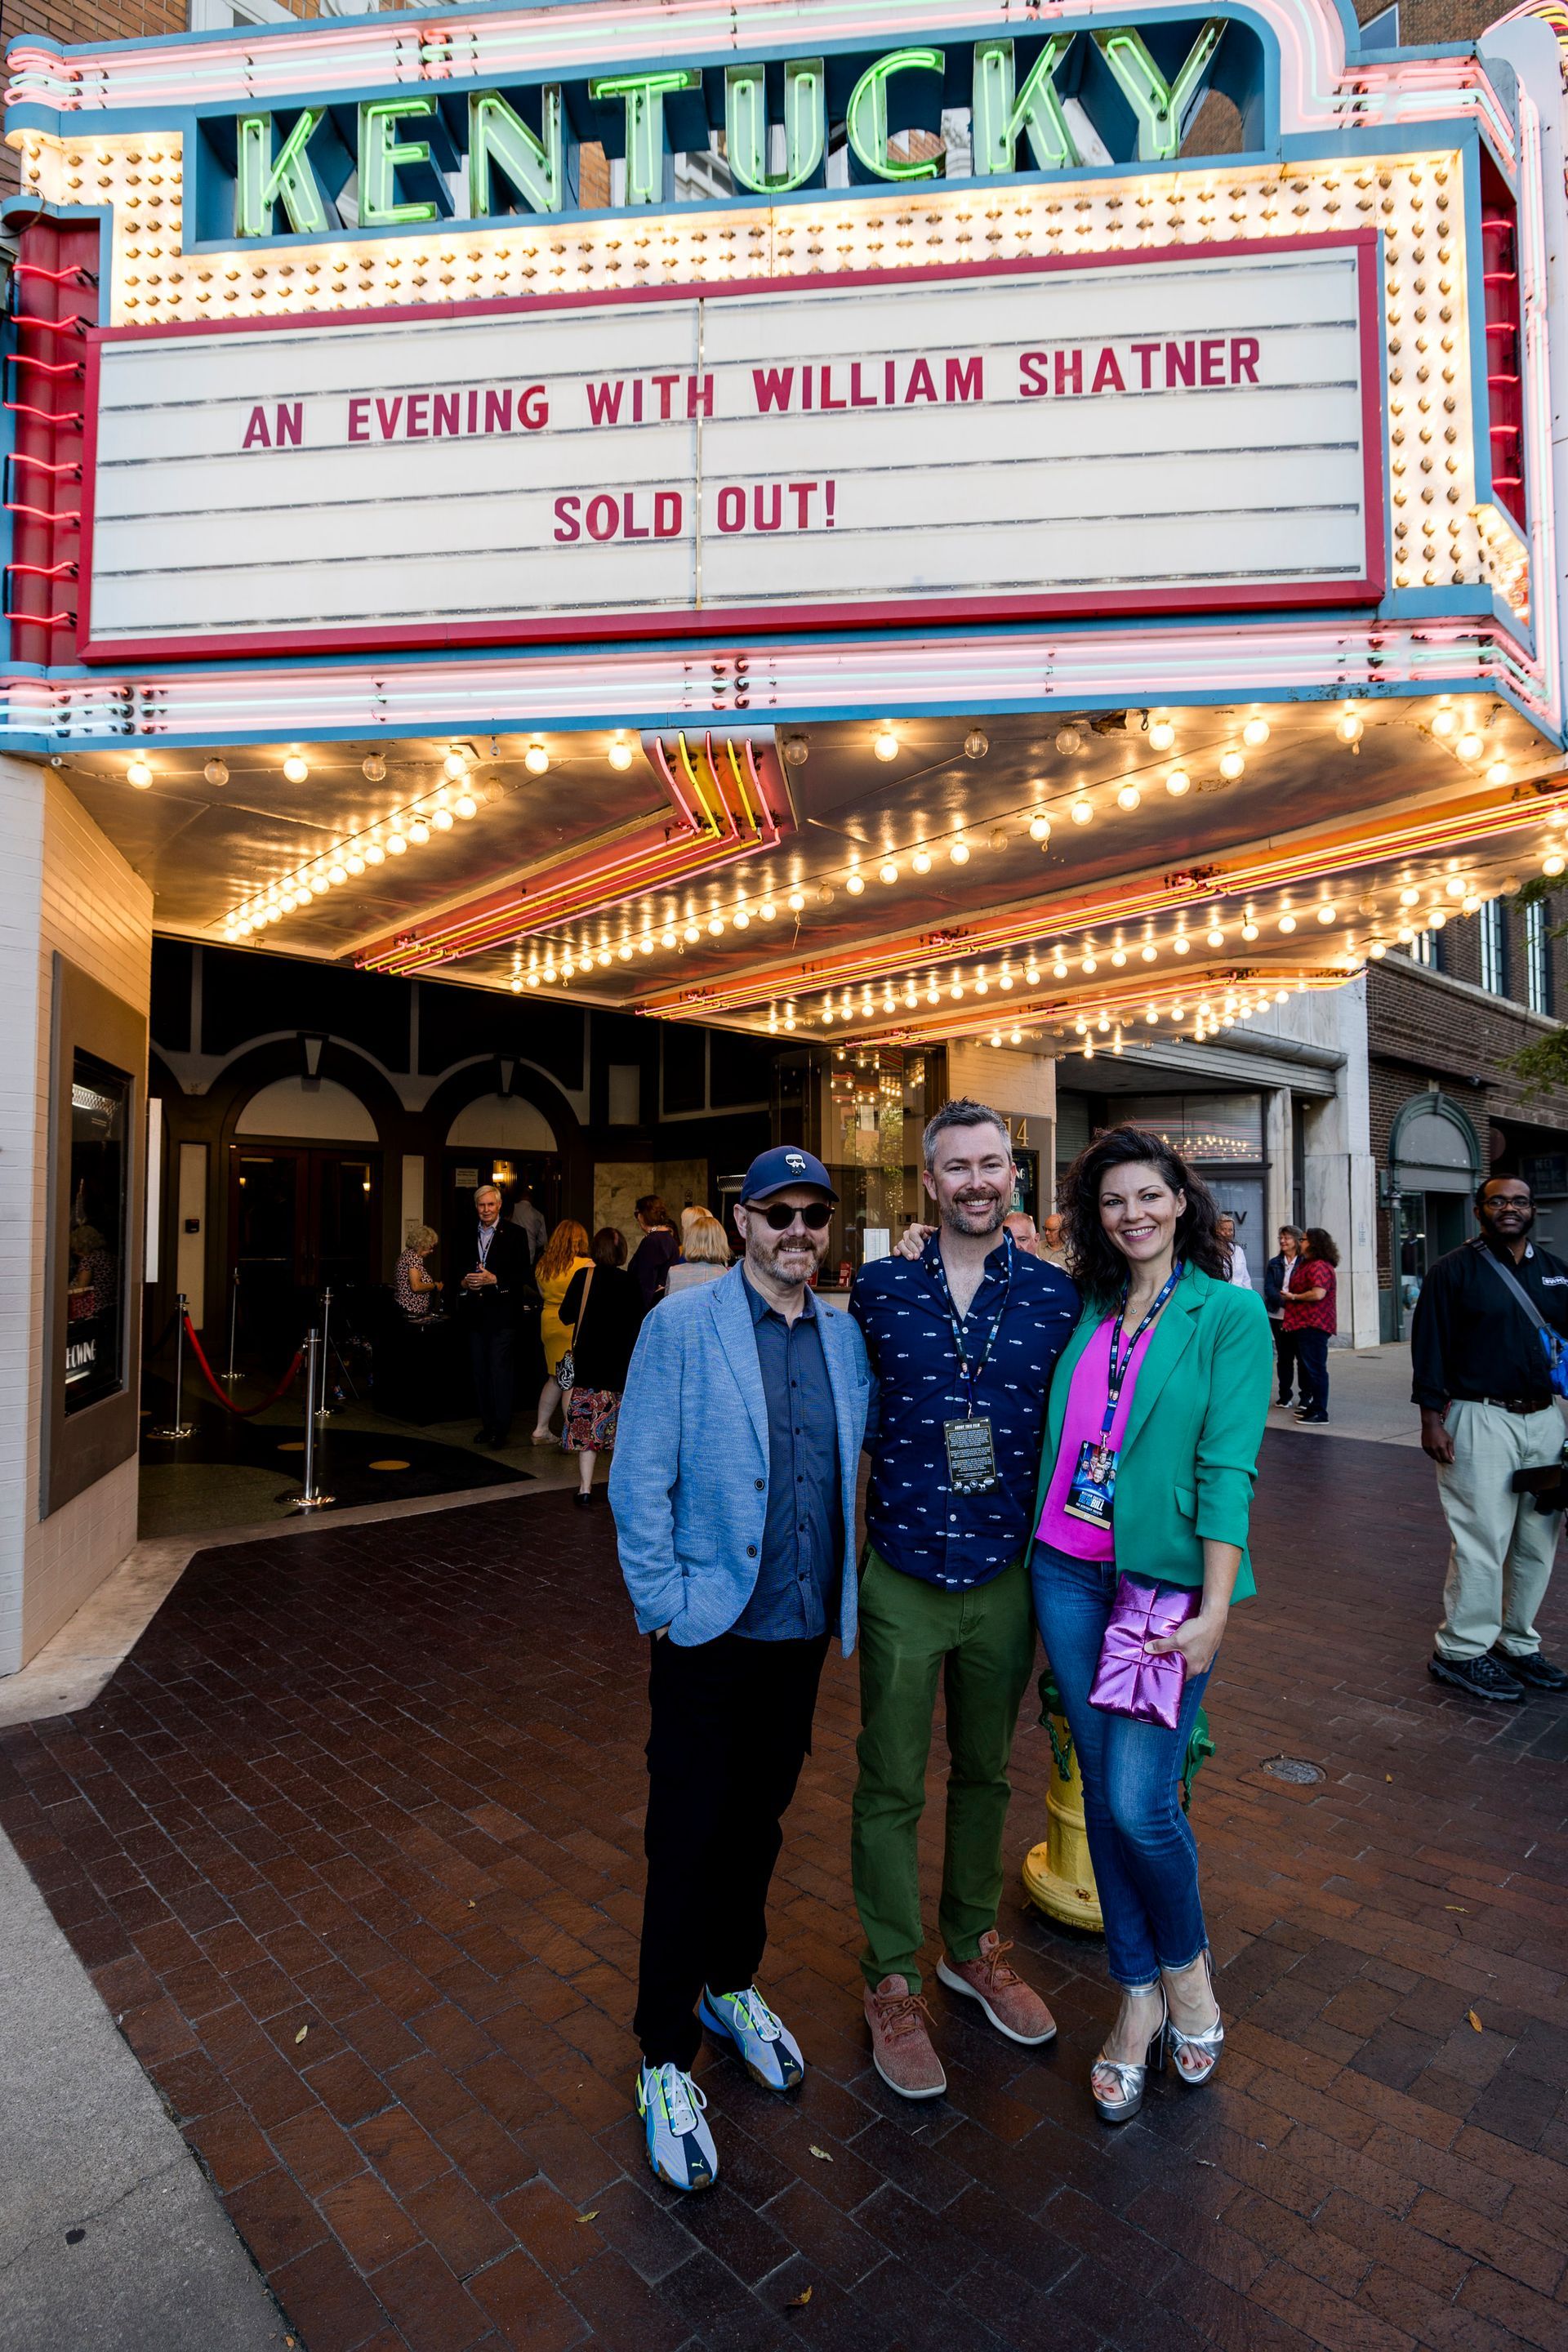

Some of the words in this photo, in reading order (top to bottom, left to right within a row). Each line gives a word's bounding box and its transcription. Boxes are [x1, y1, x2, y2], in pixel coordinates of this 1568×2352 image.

[236, 16, 1228, 238] KENTUCKY
[243, 403, 302, 448] AN
[349, 385, 549, 441] EVENING
[587, 373, 713, 425] WITH
[753, 357, 982, 412] WILLIAM
[1020, 338, 1258, 396] SHATNER
[555, 491, 682, 541] SOLD
[718, 480, 835, 532] OUT!
[1222, 1211, 1247, 1225] V
[1090, 1499, 1104, 1511] BILL
